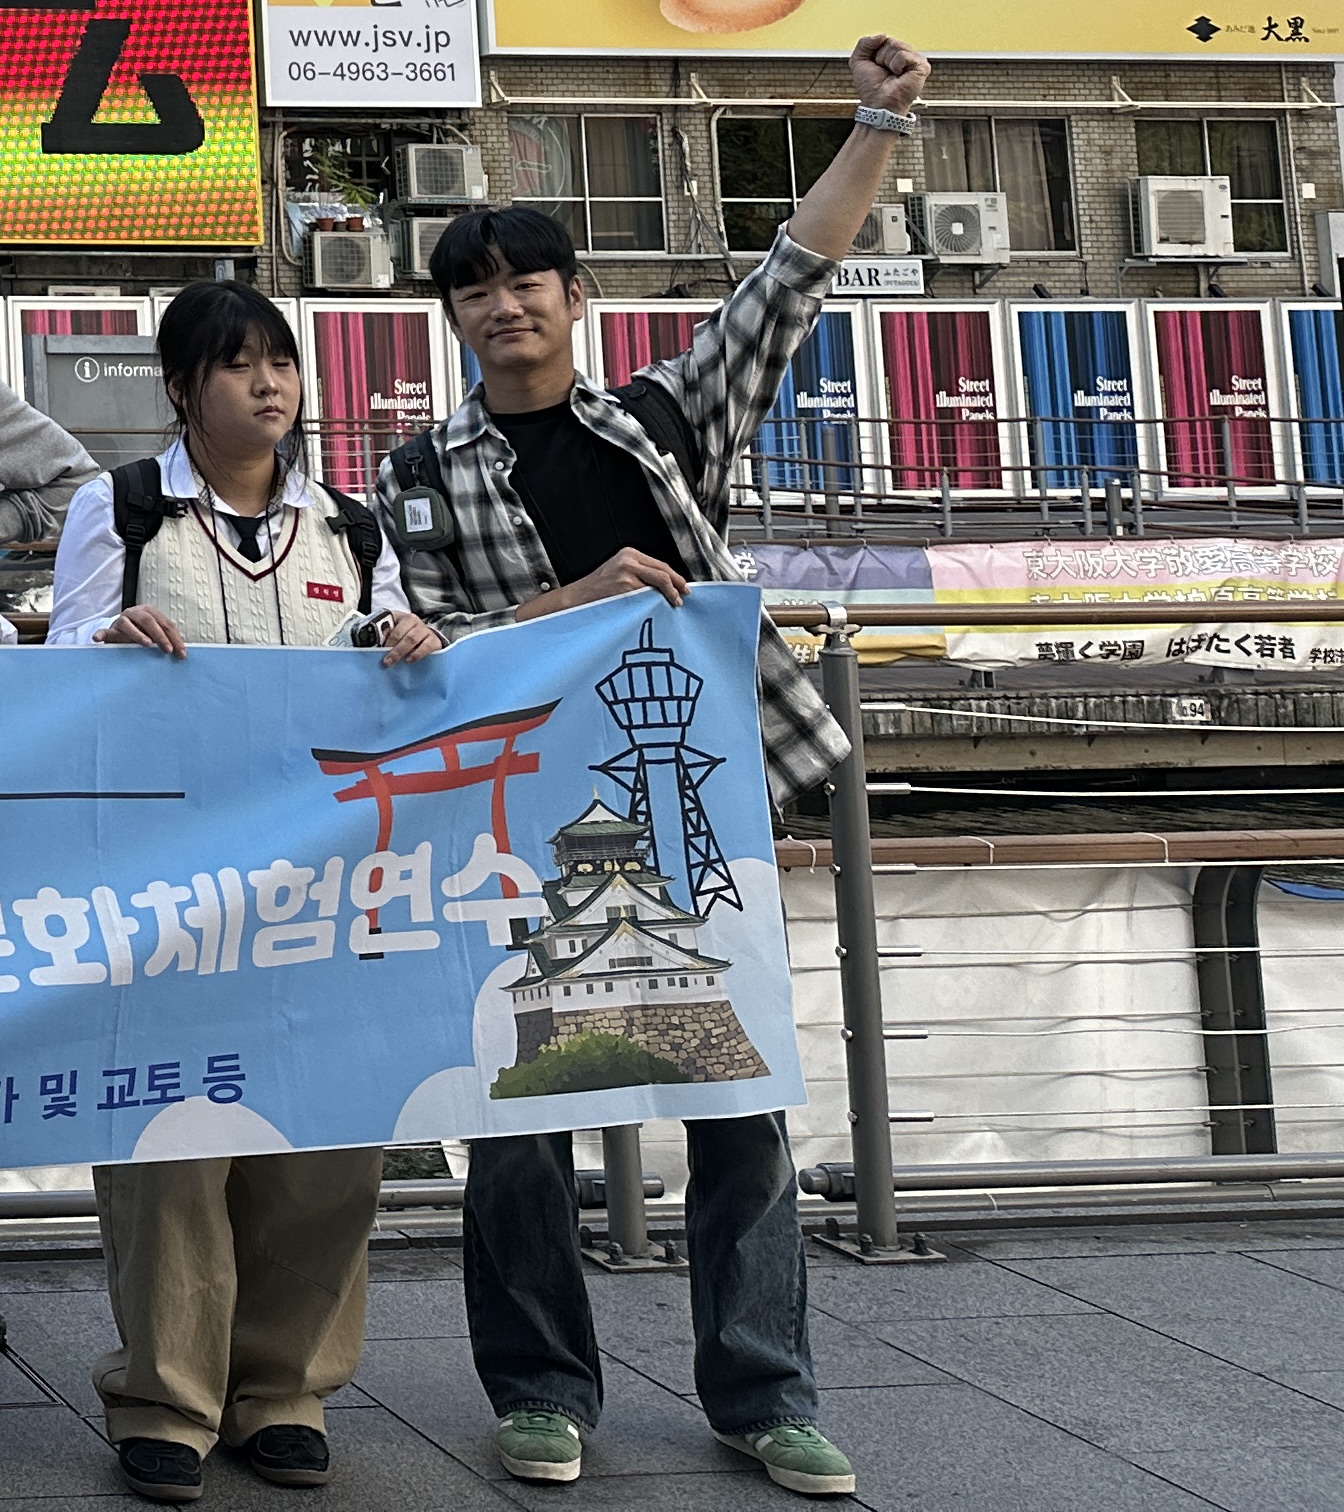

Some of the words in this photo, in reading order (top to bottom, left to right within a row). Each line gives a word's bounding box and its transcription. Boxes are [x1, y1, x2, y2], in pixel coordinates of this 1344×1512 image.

[289, 26, 451, 48] www.jsv.jp
[1261, 16, 1310, 43] 大黒
[287, 61, 456, 82] 06-4963-3661
[837, 268, 882, 287] BAR
[394, 379, 427, 394] Street
[819, 378, 851, 393] Street
[958, 377, 990, 392] Street
[1096, 376, 1127, 391] Street
[1231, 375, 1262, 390] Street
[1023, 546, 1339, 579] 東大阪大学敬愛高等学校
[1165, 633, 1296, 660] はばたく若者
[38, 1074, 80, 1120] 및
[96, 1065, 186, 1112] 교토
[201, 1054, 248, 1104] 등
